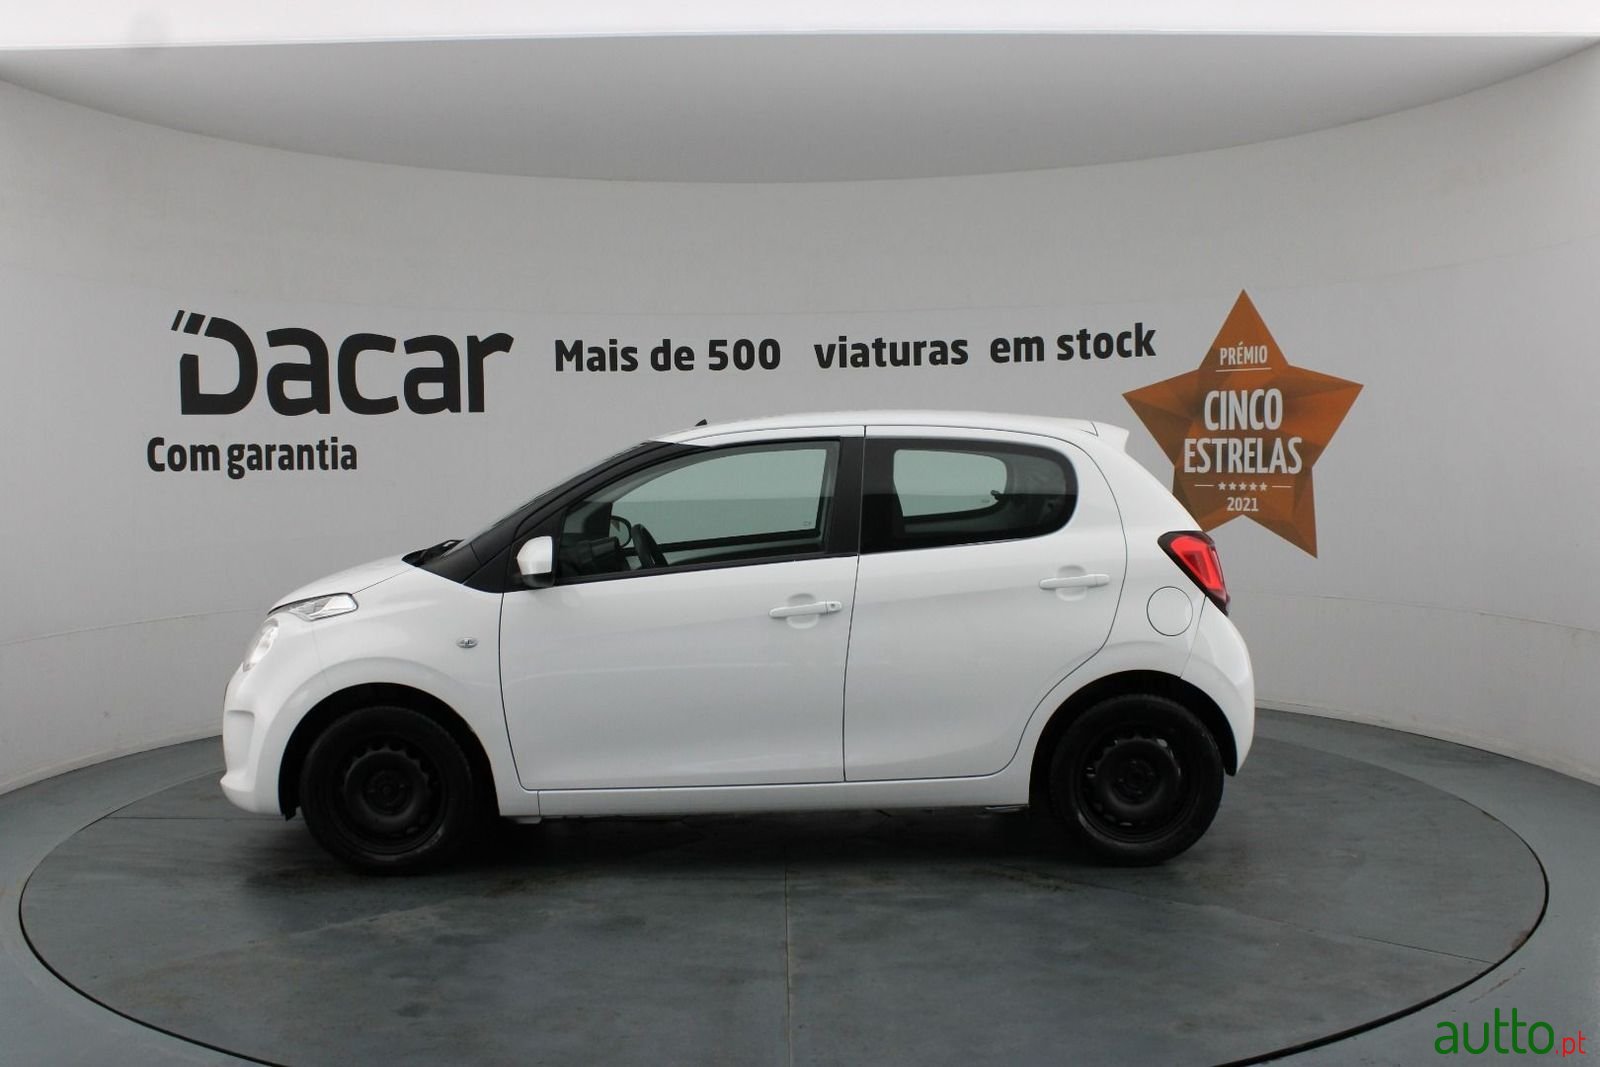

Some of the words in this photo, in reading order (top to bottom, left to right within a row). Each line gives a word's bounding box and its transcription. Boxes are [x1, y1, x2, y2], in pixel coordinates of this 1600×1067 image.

[171, 310, 514, 416] Dacar
[555, 340, 638, 372] Mais
[650, 339, 695, 371] de
[708, 338, 781, 371] 500
[814, 336, 968, 368] viaturas
[990, 336, 1044, 363] em
[1056, 323, 1156, 360] stock
[1219, 341, 1268, 366] PRÉMIO
[1203, 388, 1283, 431] CINCO
[147, 437, 220, 472] Com
[227, 436, 358, 479] garantia
[1183, 437, 1303, 475] ESTRELAS
[1226, 497, 1259, 512] 2021
